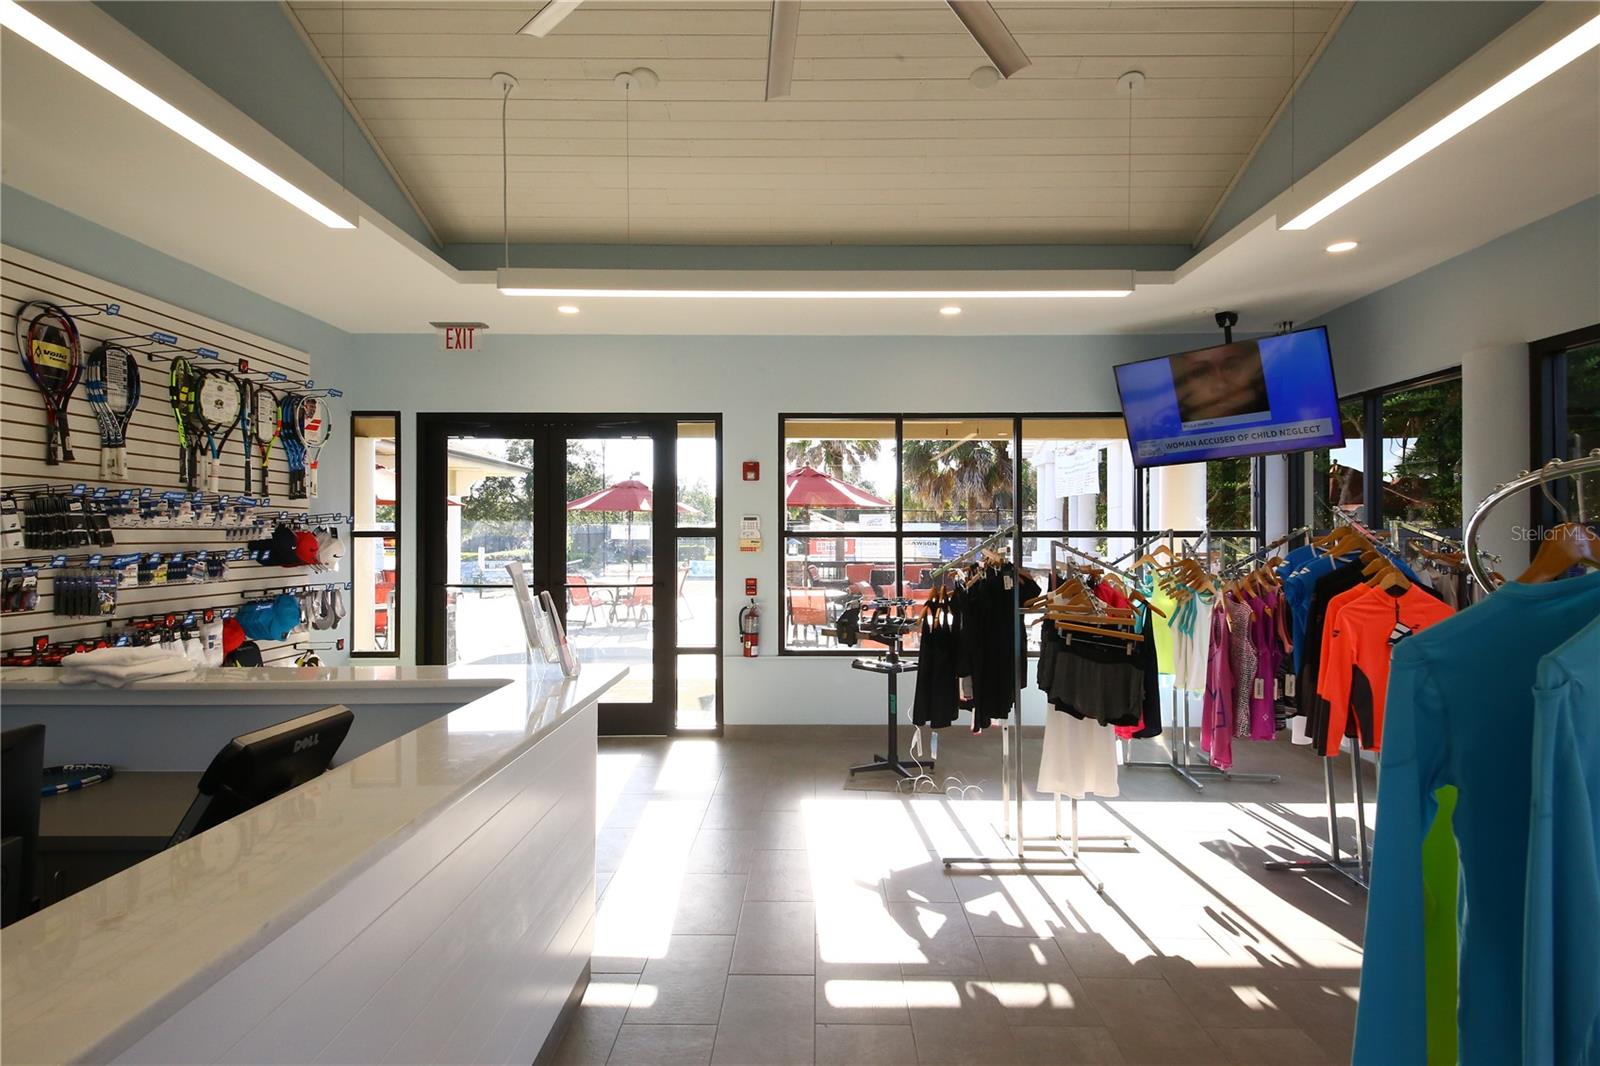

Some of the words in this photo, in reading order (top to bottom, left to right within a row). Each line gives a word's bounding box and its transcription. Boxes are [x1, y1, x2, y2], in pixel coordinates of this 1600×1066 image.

[446, 327, 475, 349] EXIT
[1165, 440, 1197, 450] WOMAN
[1198, 435, 1236, 446] ACCUSED
[1237, 433, 1249, 441] OF
[1251, 430, 1278, 440] CHILD
[1279, 424, 1321, 437] NEGLECT
